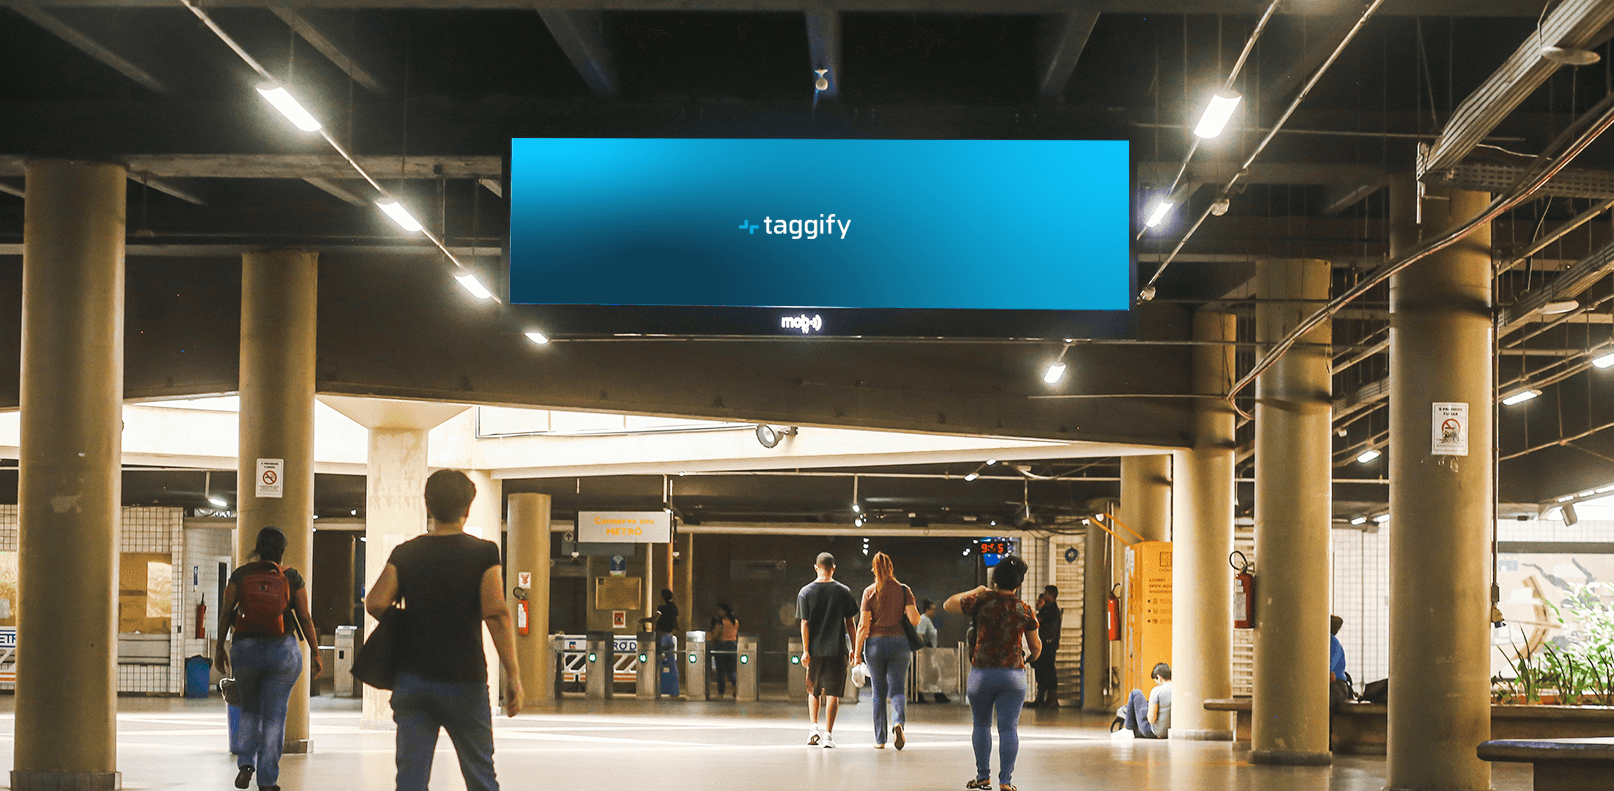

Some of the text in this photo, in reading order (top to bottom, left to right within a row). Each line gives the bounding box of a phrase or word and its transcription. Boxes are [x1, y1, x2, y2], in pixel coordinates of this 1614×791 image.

[763, 213, 852, 240] taggify
[594, 516, 637, 525] Conserve
[606, 526, 643, 536] METRÔ
